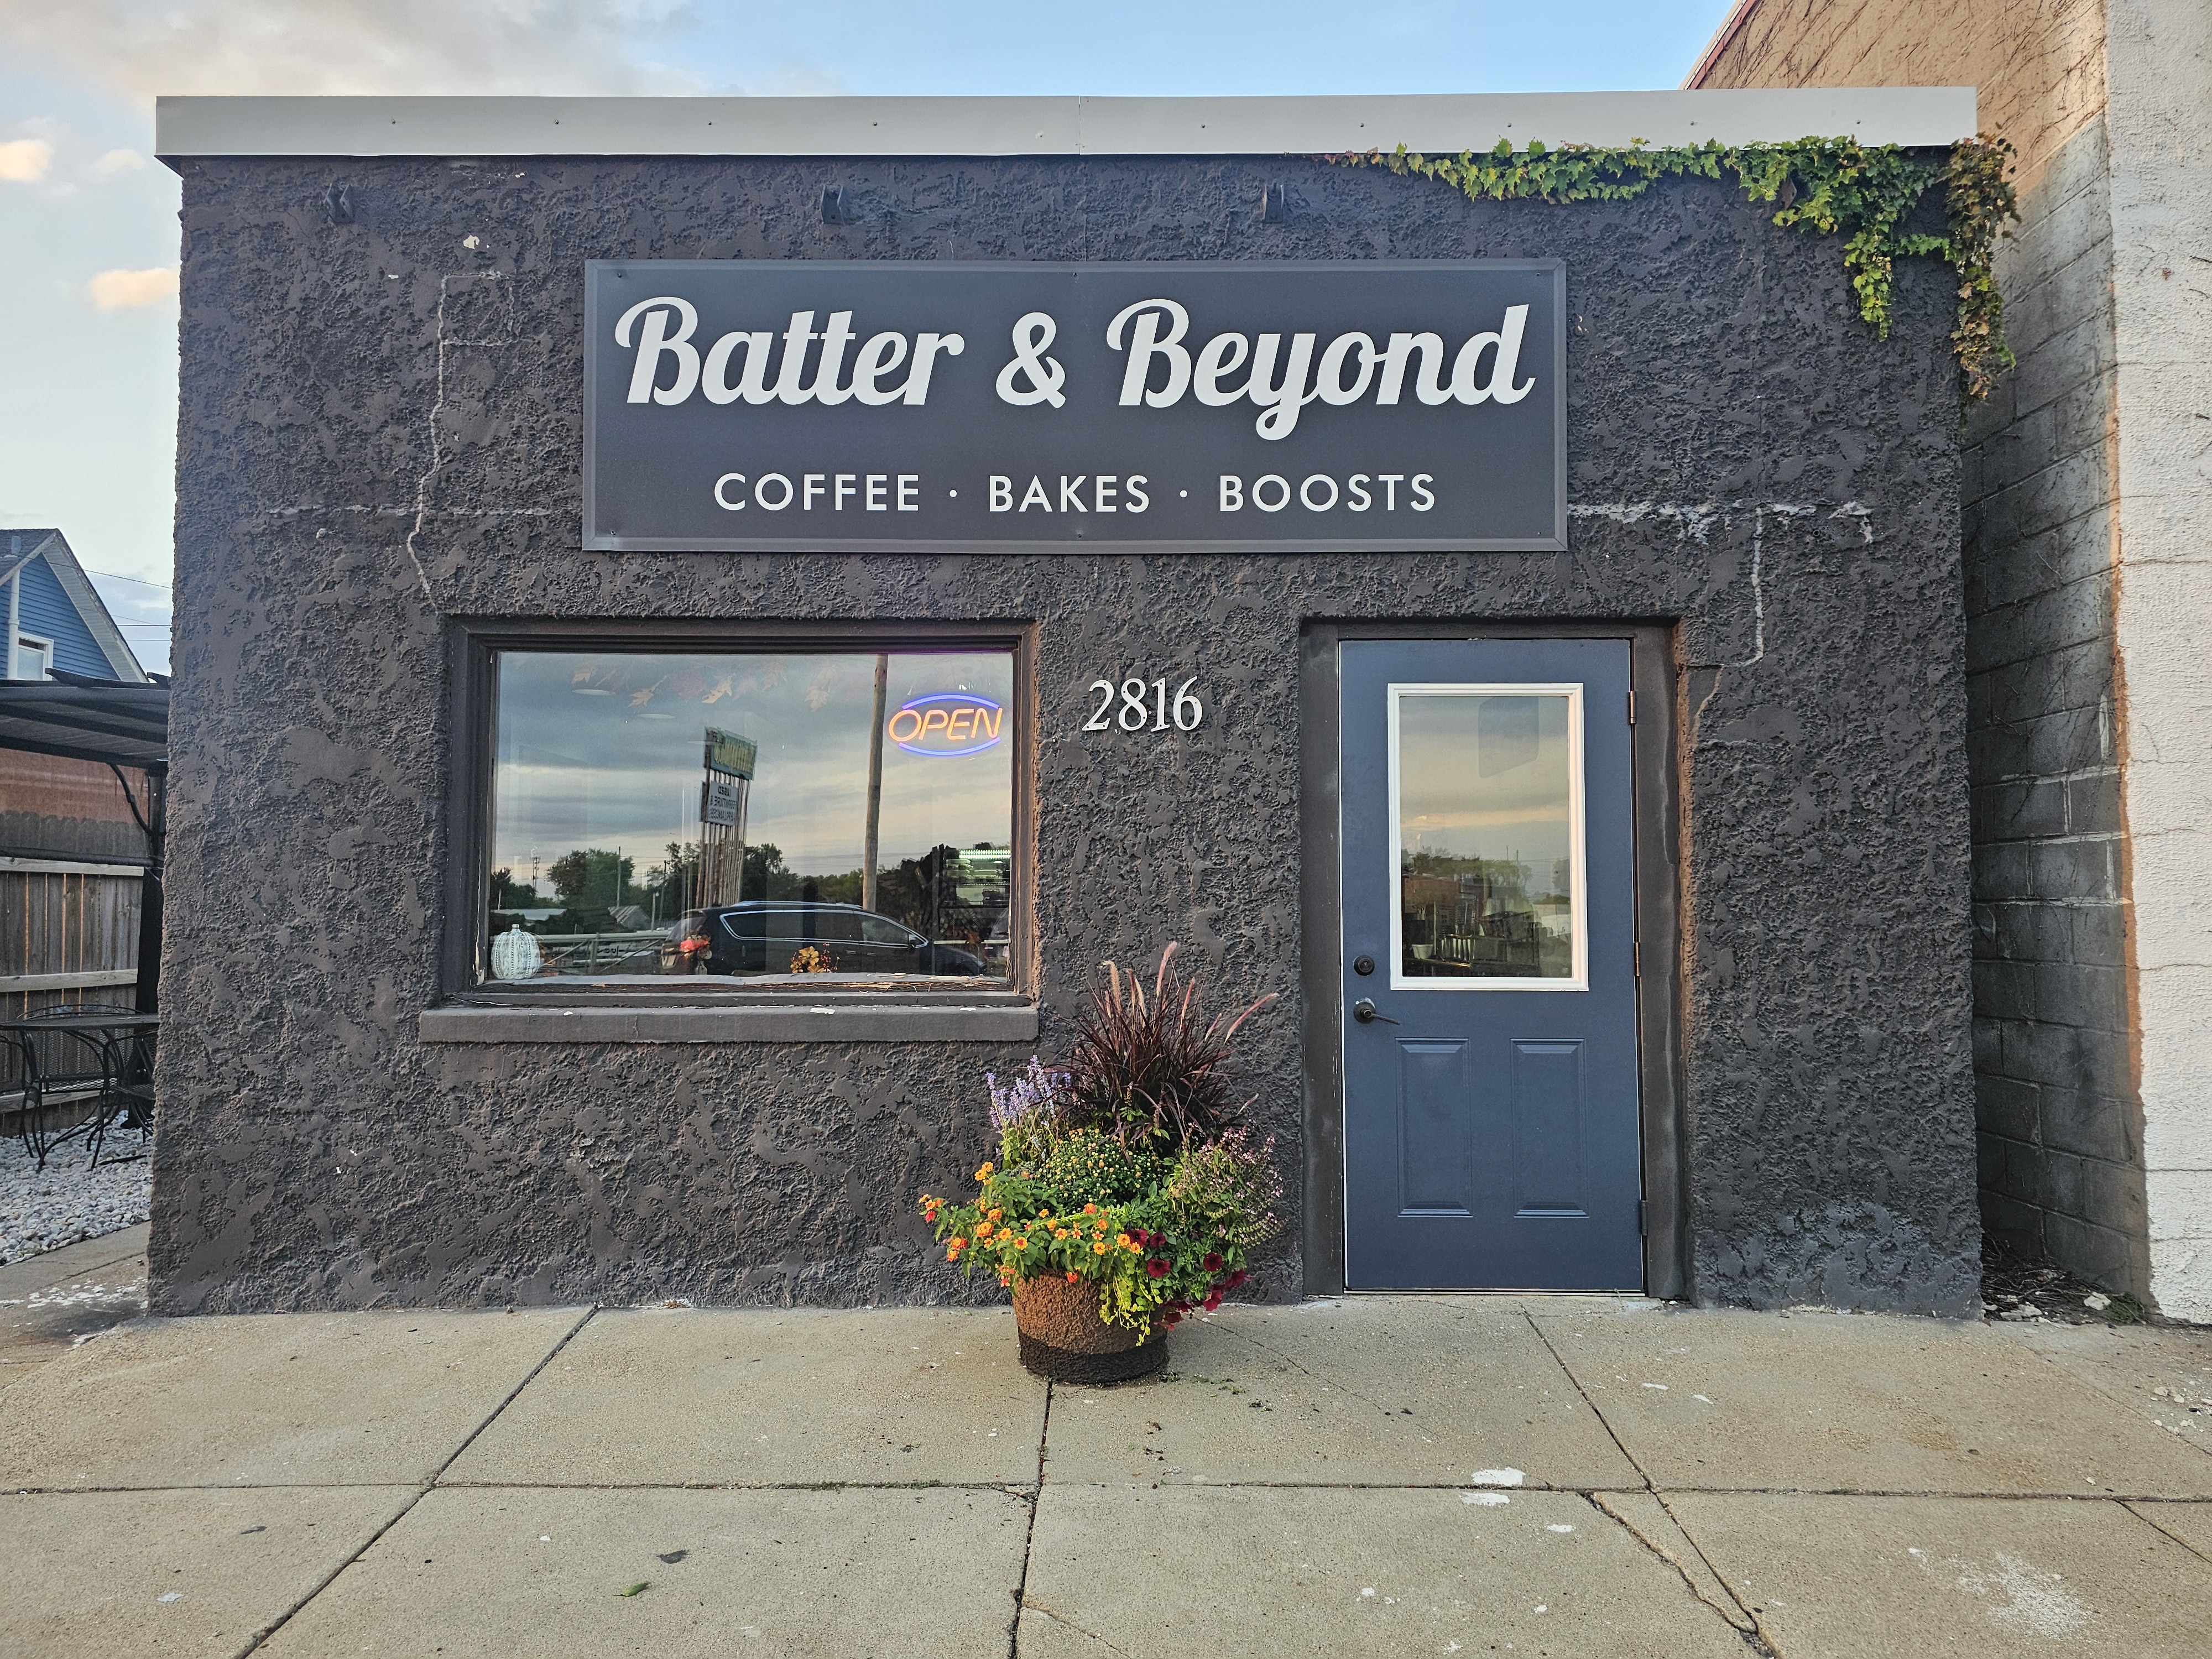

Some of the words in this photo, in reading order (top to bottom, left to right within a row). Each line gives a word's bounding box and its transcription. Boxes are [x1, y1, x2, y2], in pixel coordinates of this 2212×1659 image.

[614, 296, 965, 406] Batter
[995, 312, 1066, 409] &
[1106, 299, 1536, 441] Beyond
[714, 473, 919, 511] COFFEE
[989, 474, 1150, 513] BAKES
[1219, 473, 1436, 512] BOOSTS
[888, 707, 1003, 743] OPEN
[1082, 676, 1203, 732] 2816
